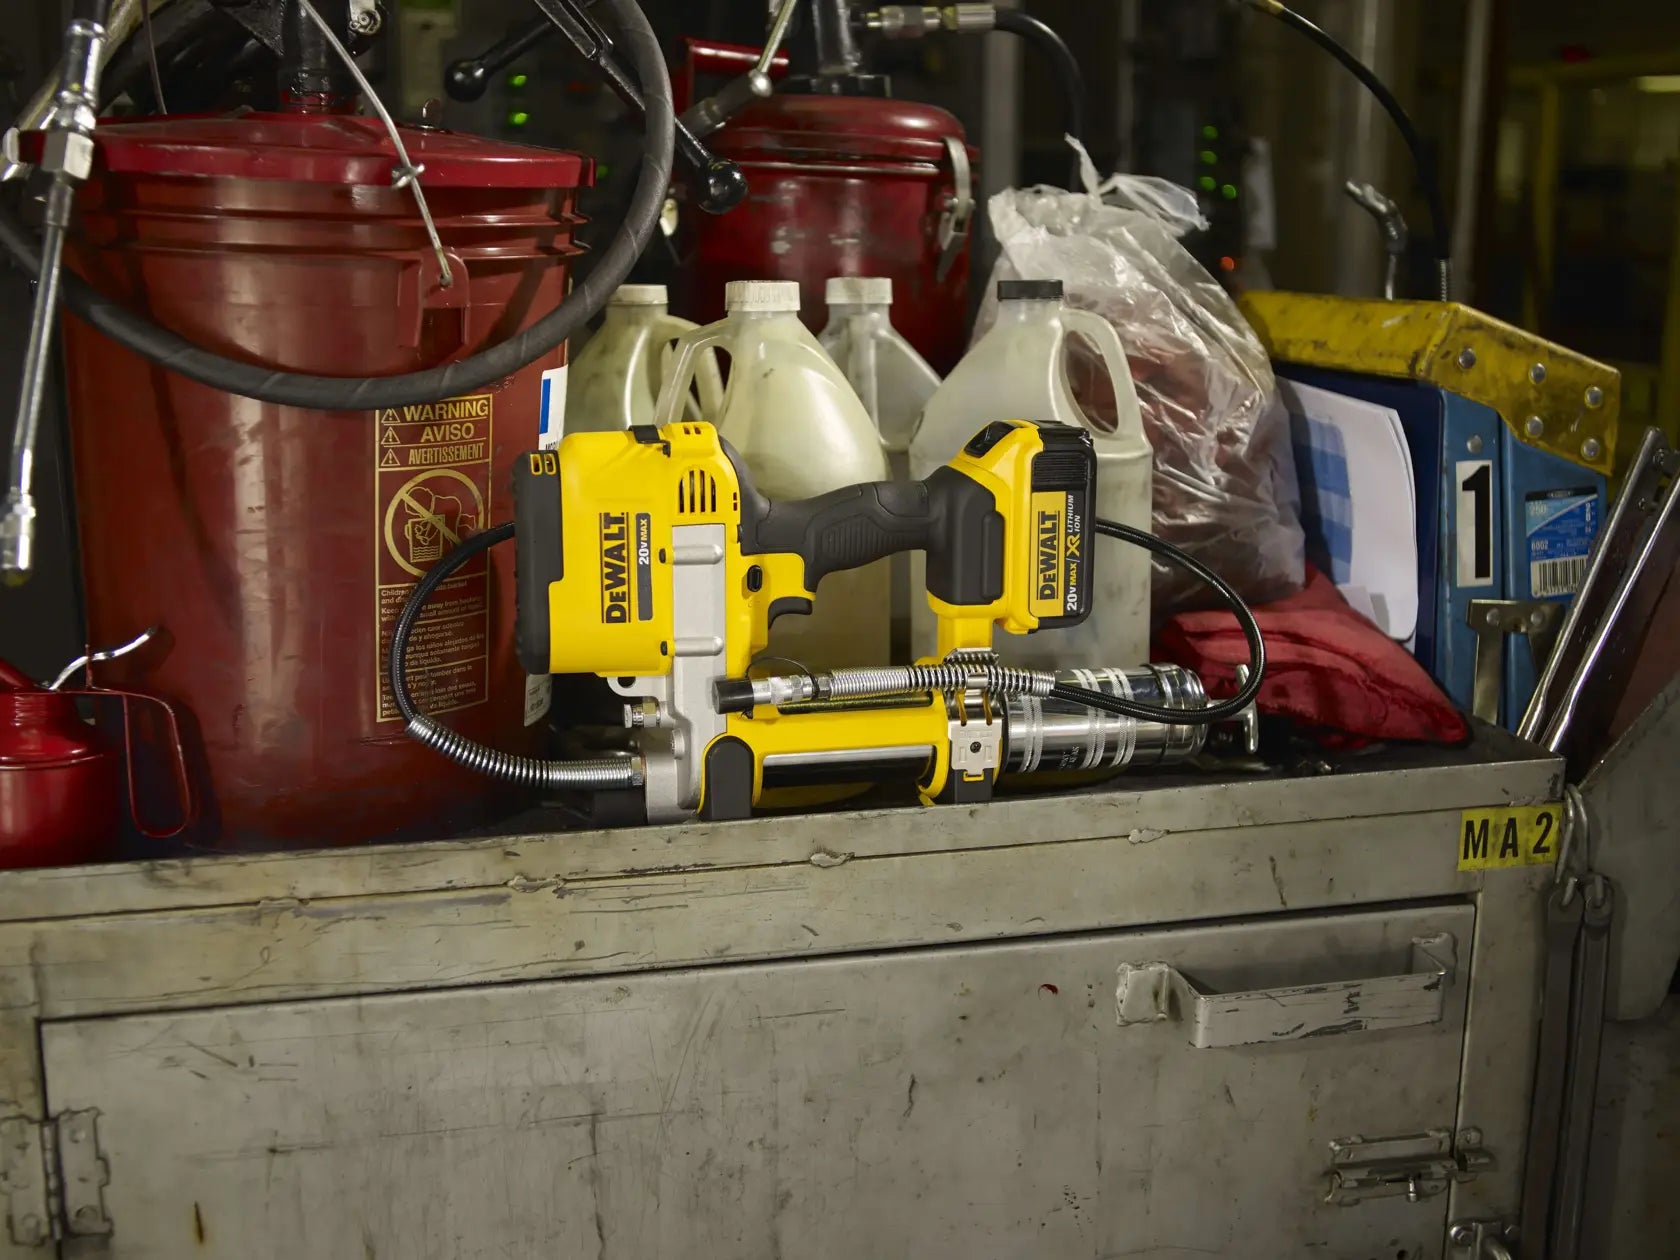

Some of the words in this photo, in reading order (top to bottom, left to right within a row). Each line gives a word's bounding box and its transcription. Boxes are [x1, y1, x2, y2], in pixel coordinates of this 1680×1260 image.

[404, 400, 489, 421] WARNING
[420, 423, 475, 443] AVISO
[408, 443, 484, 465] AVERTISSEMENT
[1462, 464, 1490, 578] 1
[1066, 534, 1080, 557] XR
